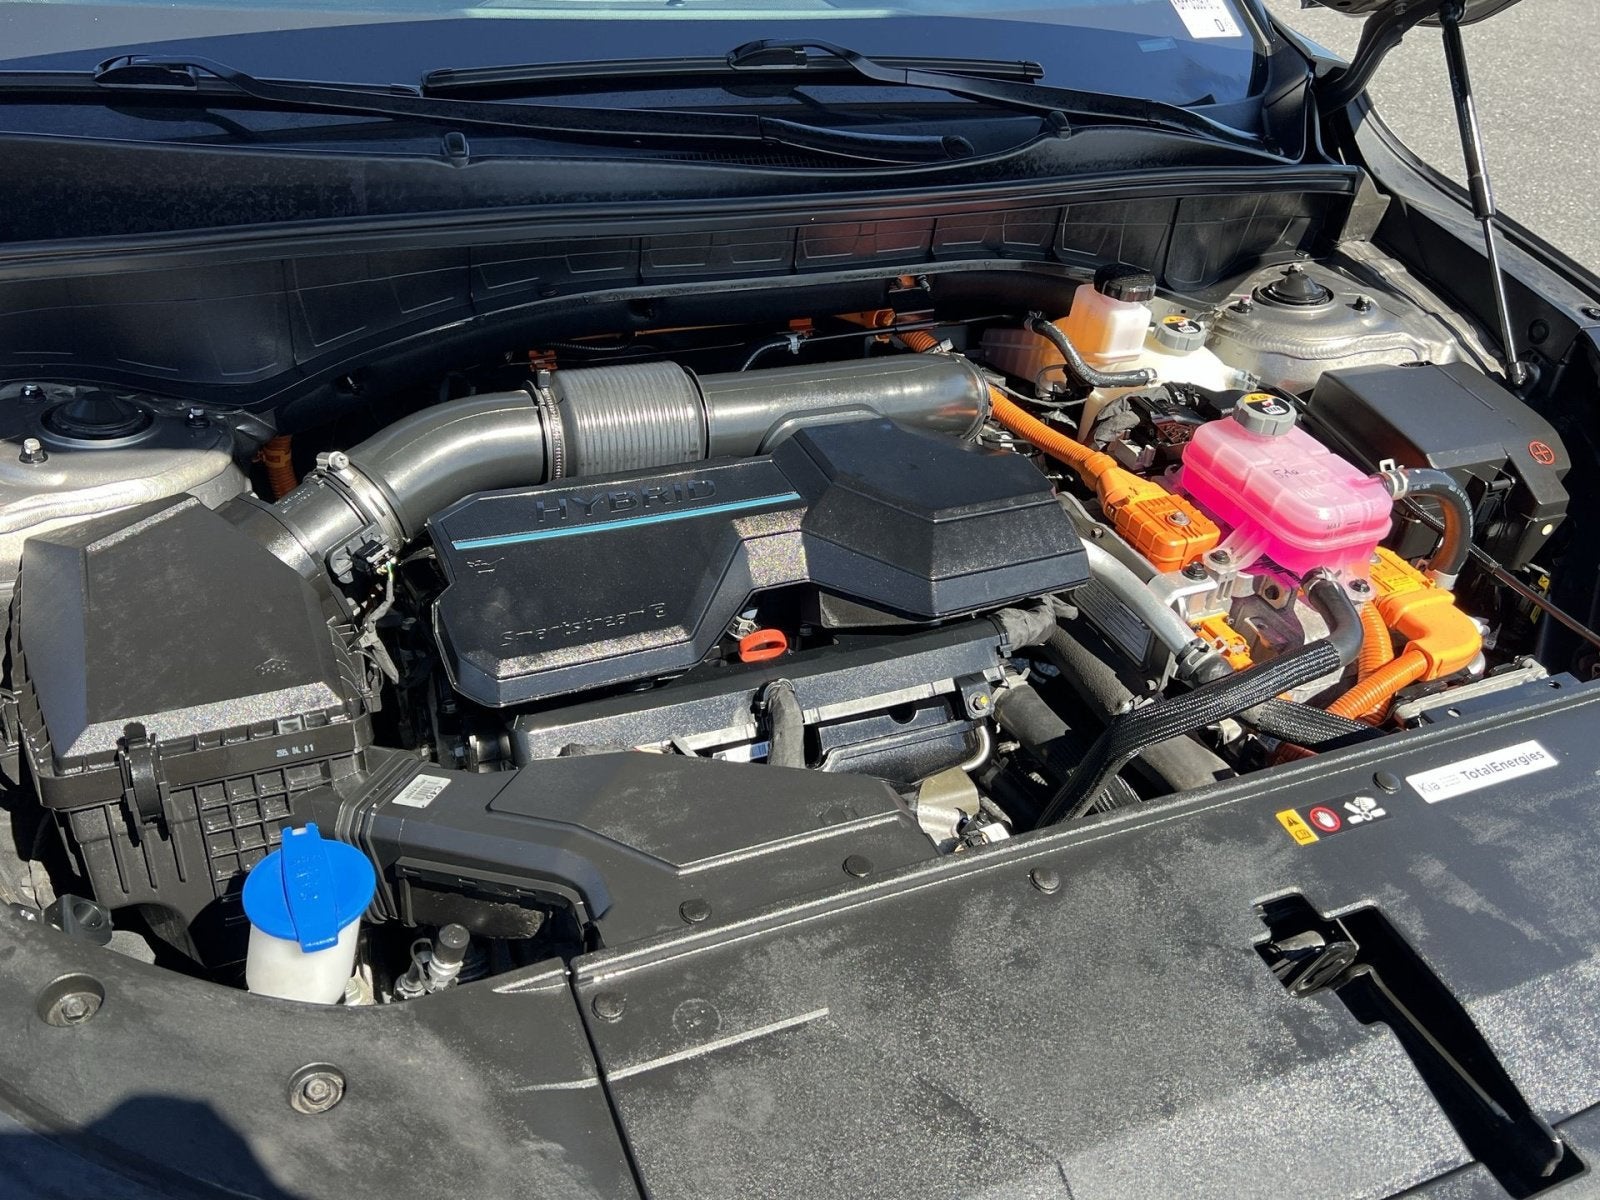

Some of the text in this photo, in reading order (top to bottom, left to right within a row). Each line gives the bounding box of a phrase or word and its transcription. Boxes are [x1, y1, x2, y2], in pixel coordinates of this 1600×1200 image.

[536, 480, 717, 522] HYBRID
[1417, 780, 1441, 795] Kia
[1459, 750, 1546, 781] TotalEnergies
